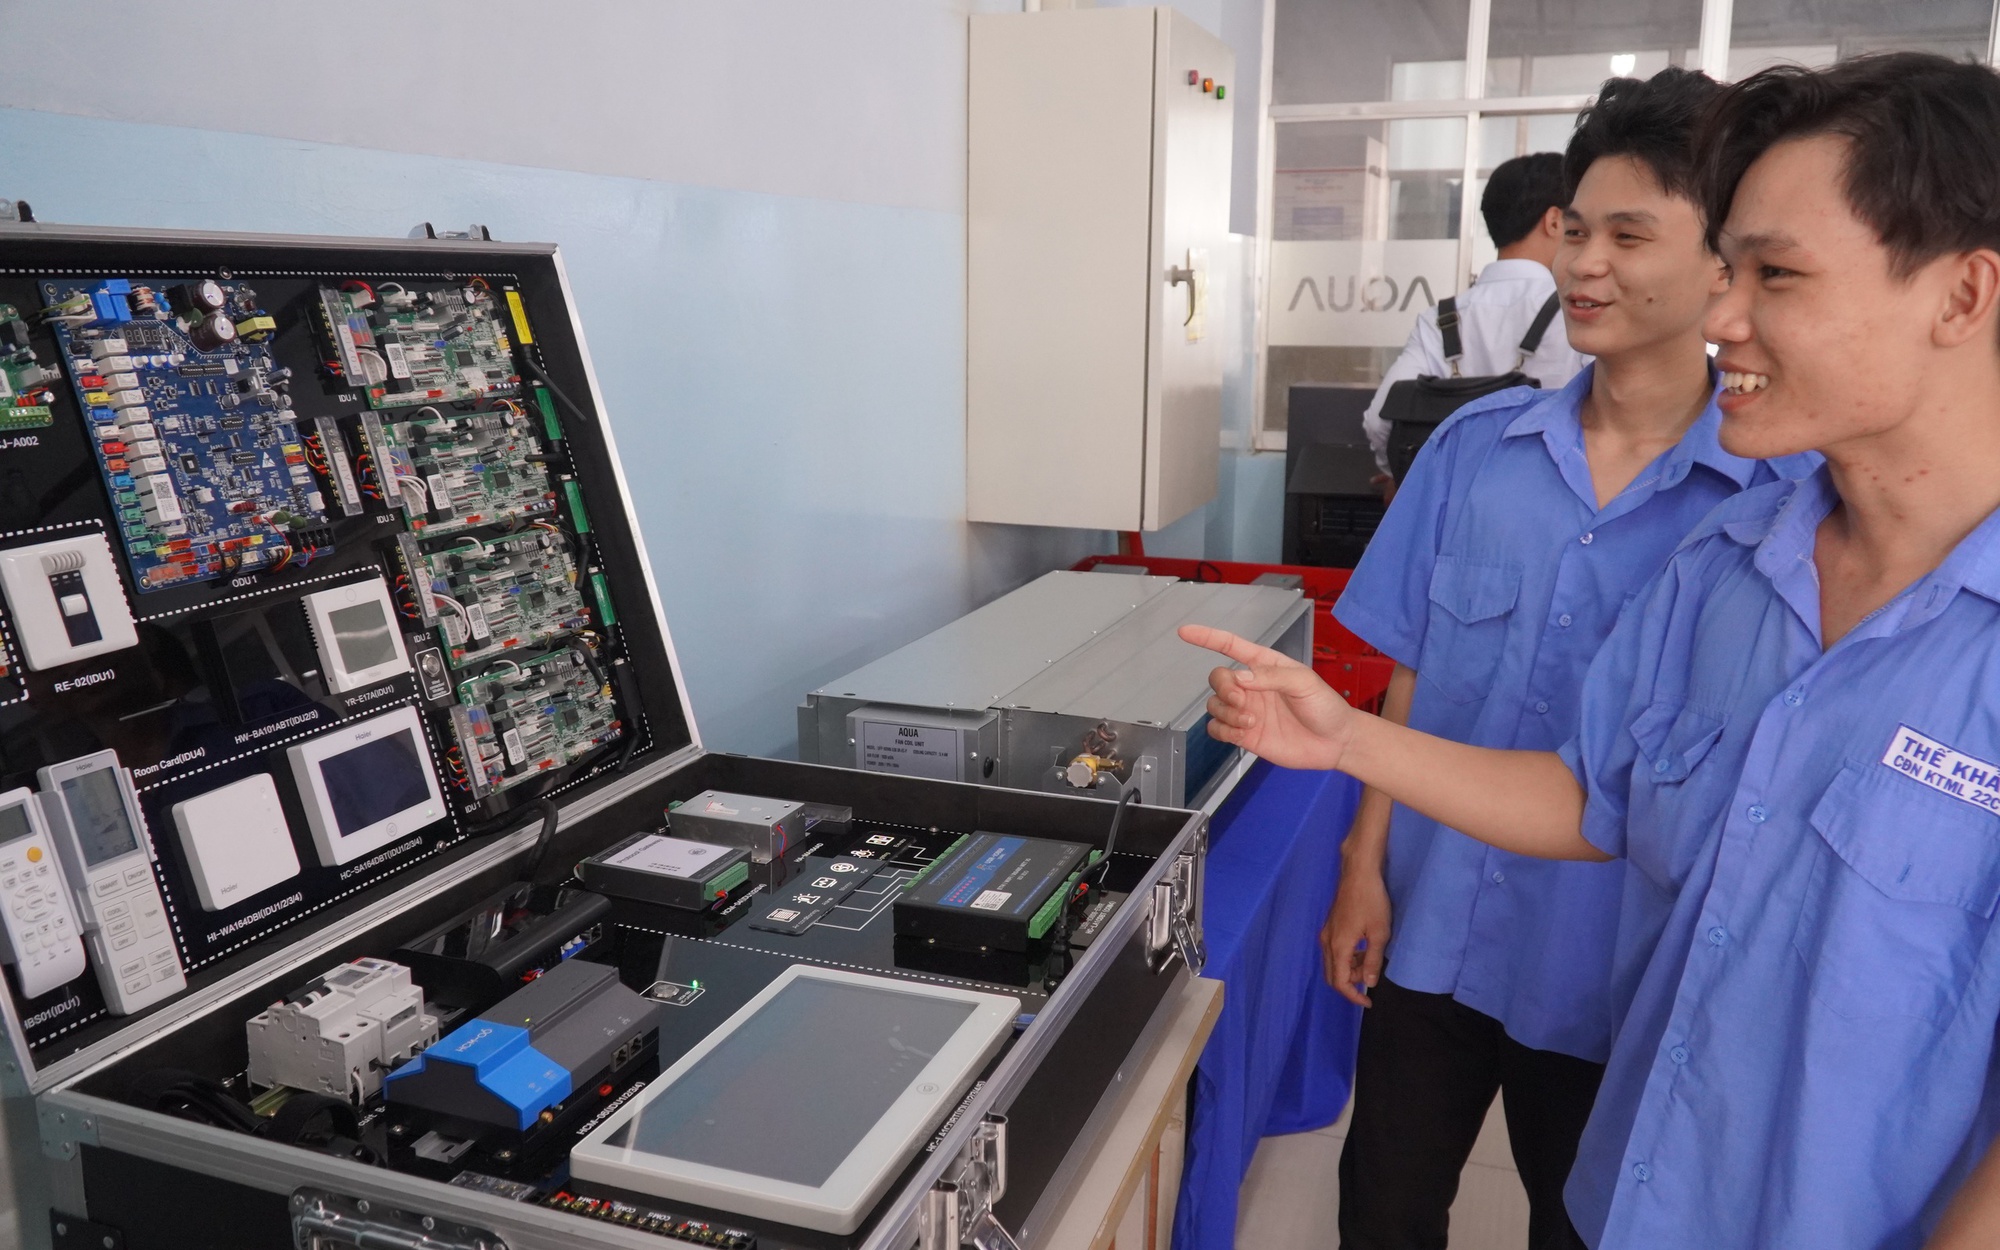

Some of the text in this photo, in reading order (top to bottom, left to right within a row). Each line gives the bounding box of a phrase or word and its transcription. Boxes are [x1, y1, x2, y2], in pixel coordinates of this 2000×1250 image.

[338, 394, 352, 403] IDU
[376, 515, 389, 524] IDU
[232, 577, 251, 588] ODU
[413, 634, 426, 643] IDU
[54, 668, 115, 693] RE-02(IDU1)
[898, 727, 919, 738] AQUA
[133, 746, 206, 778] Room Card(IDU4)
[1924, 769, 1965, 797] KTML
[465, 803, 477, 814] IDU
